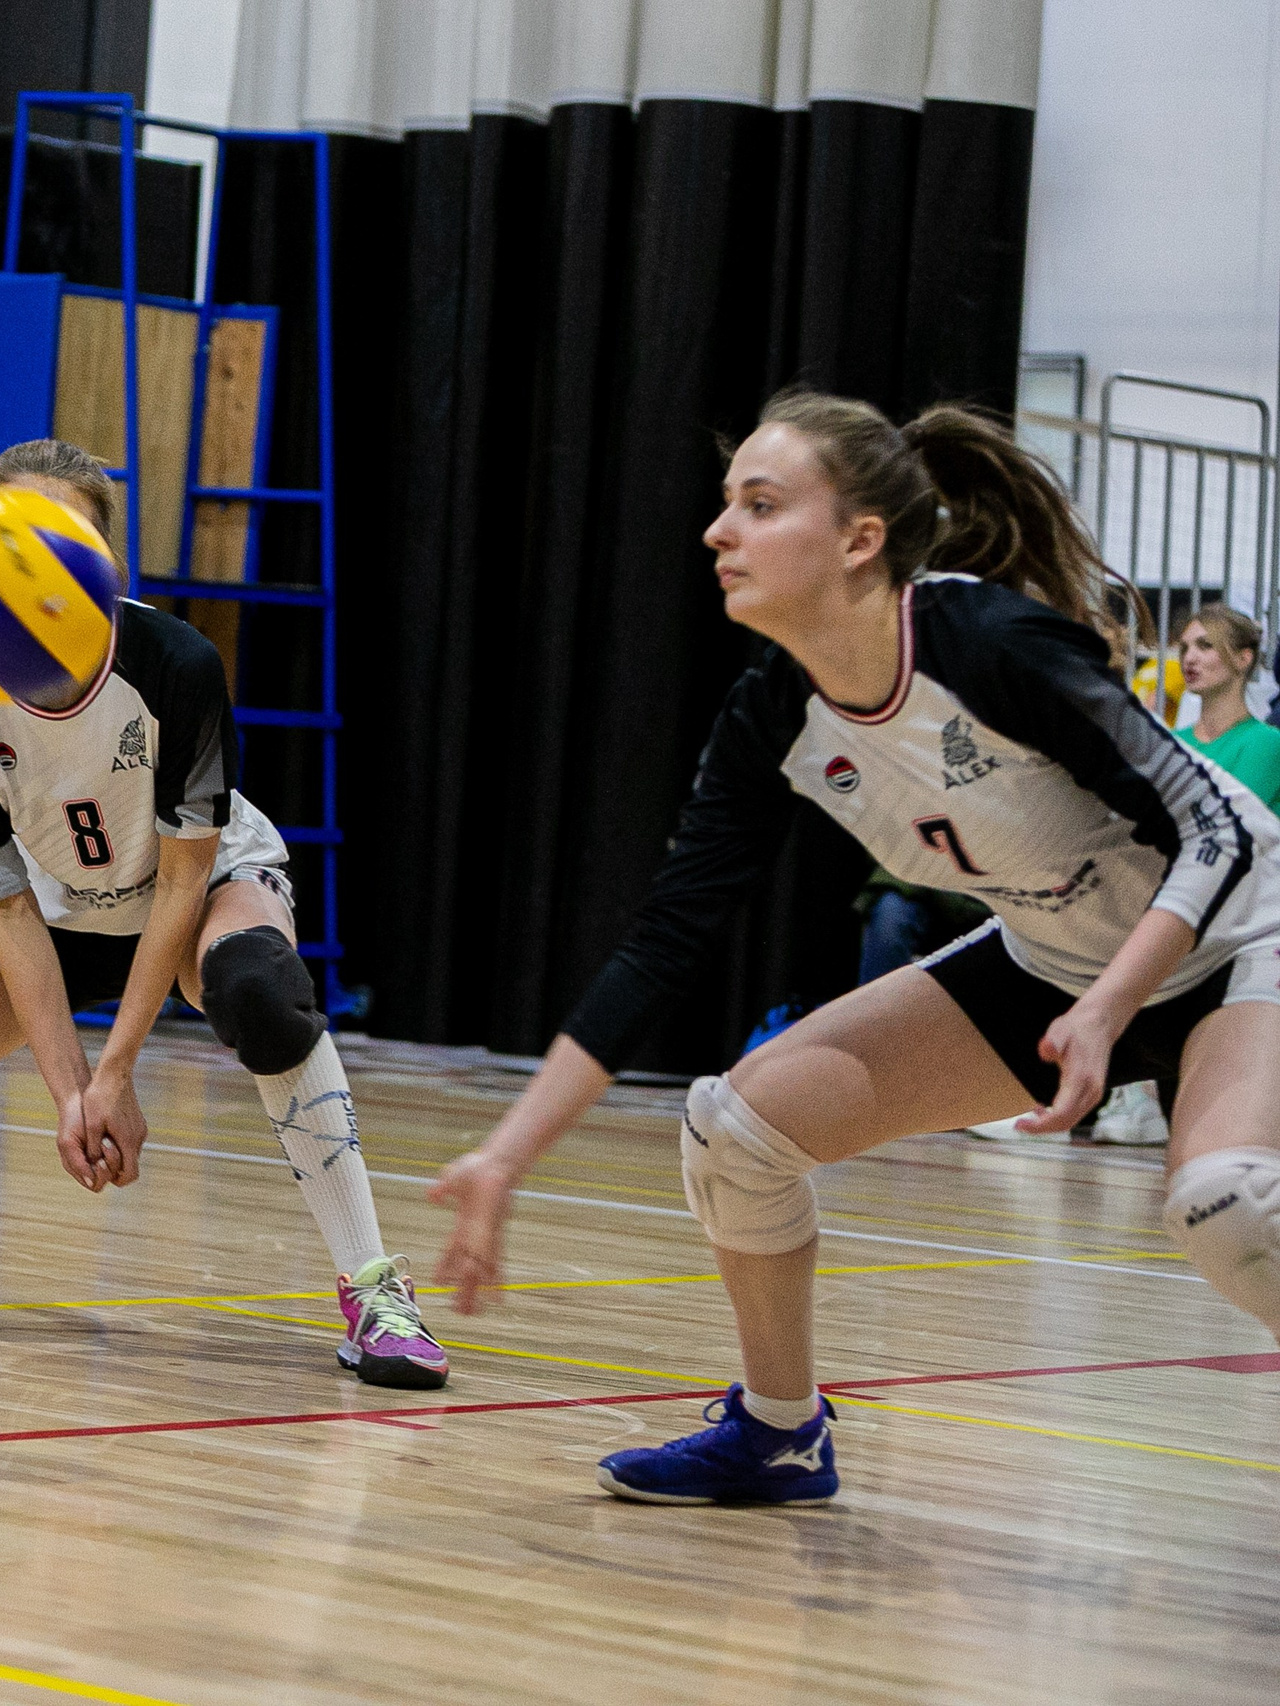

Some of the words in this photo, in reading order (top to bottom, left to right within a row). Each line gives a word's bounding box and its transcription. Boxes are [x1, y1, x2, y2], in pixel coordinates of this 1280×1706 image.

[111, 754, 153, 773] ALE
[942, 755, 1001, 790] ALEX
[61, 798, 115, 870] 8
[912, 813, 992, 877] 7
